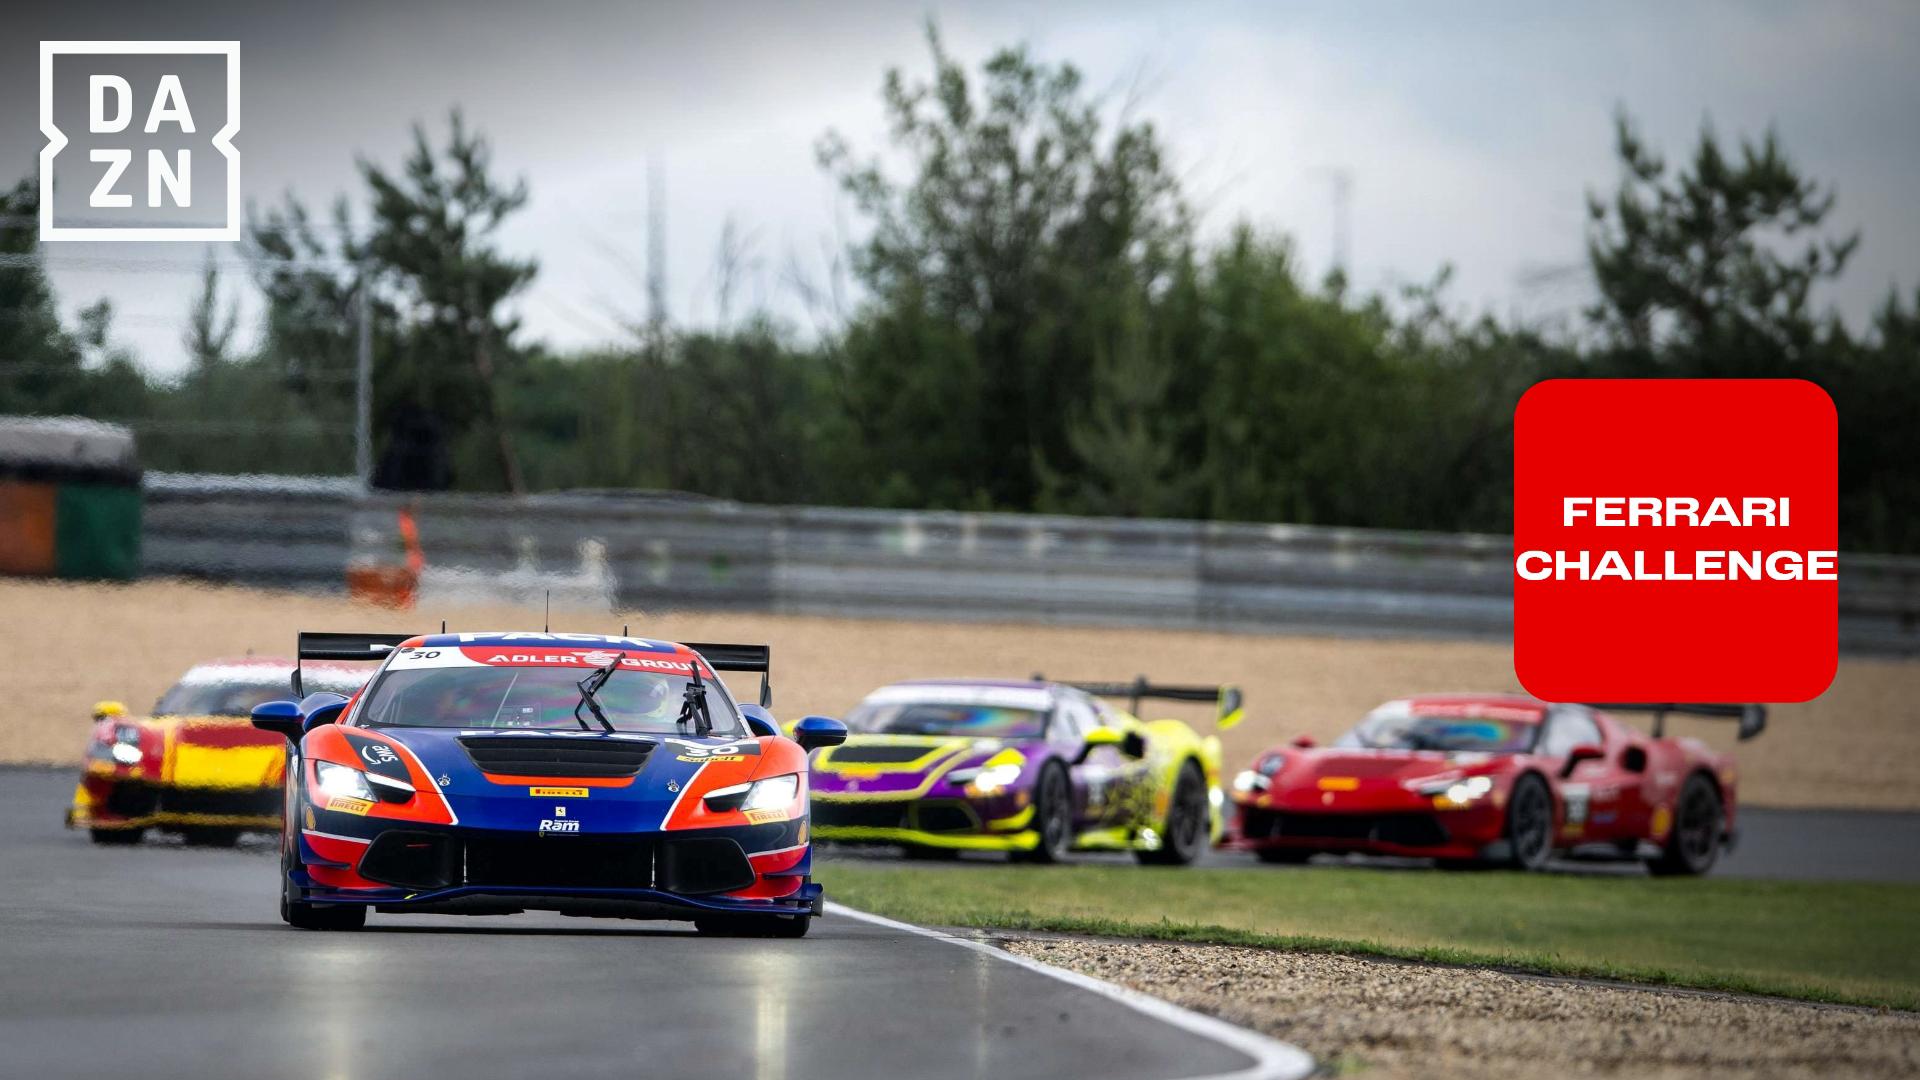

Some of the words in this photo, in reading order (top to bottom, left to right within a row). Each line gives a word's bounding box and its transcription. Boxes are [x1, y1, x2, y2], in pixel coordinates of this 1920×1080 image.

[409, 651, 441, 660] 30
[486, 654, 578, 663] ADLER
[371, 745, 399, 763] aws
[685, 746, 740, 757] 30
[329, 798, 367, 813] PIRELLI
[539, 819, 580, 831] Ram
